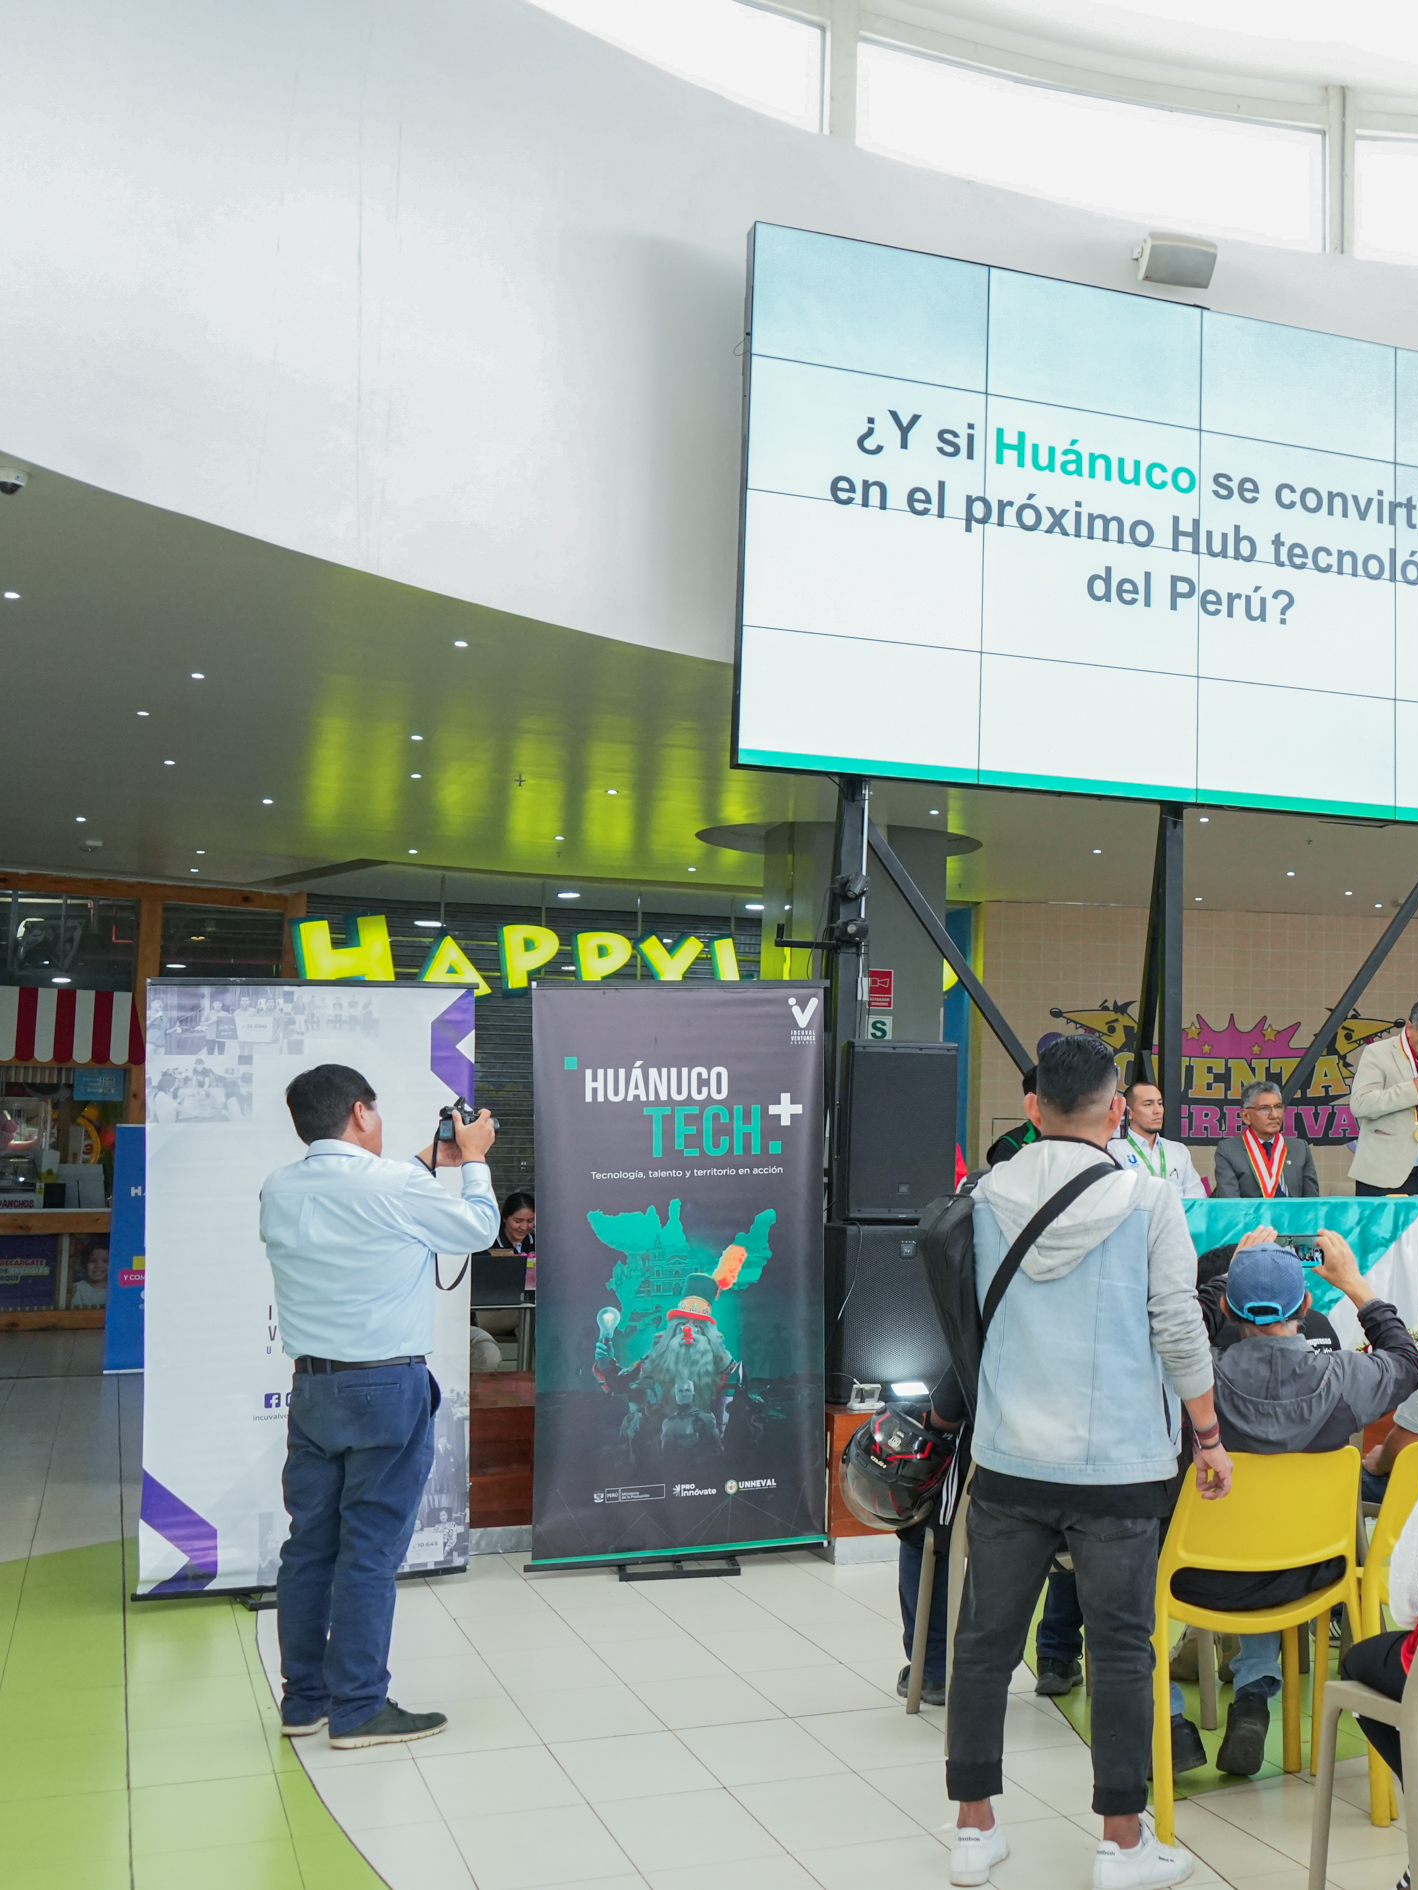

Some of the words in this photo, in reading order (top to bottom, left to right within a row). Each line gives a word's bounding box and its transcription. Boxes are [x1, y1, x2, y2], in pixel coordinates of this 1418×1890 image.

[856, 409, 921, 456] ¿Y
[936, 422, 976, 461] si
[995, 427, 1197, 494] Huánuco
[1212, 468, 1260, 504] se
[830, 474, 887, 512] en
[906, 480, 945, 519] el
[965, 490, 1154, 548] próximo
[1171, 516, 1257, 564] Hub
[1086, 566, 1152, 608] del
[1170, 575, 1295, 626] Perú?
[870, 1020, 887, 1040] S
[584, 1061, 729, 1102] HUÁNUCO
[591, 1170, 646, 1180] Tecnología,
[648, 1169, 683, 1178] talento
[694, 1167, 736, 1176] territorio
[752, 1166, 783, 1175] acción
[738, 1478, 777, 1488] UNHEVAL
